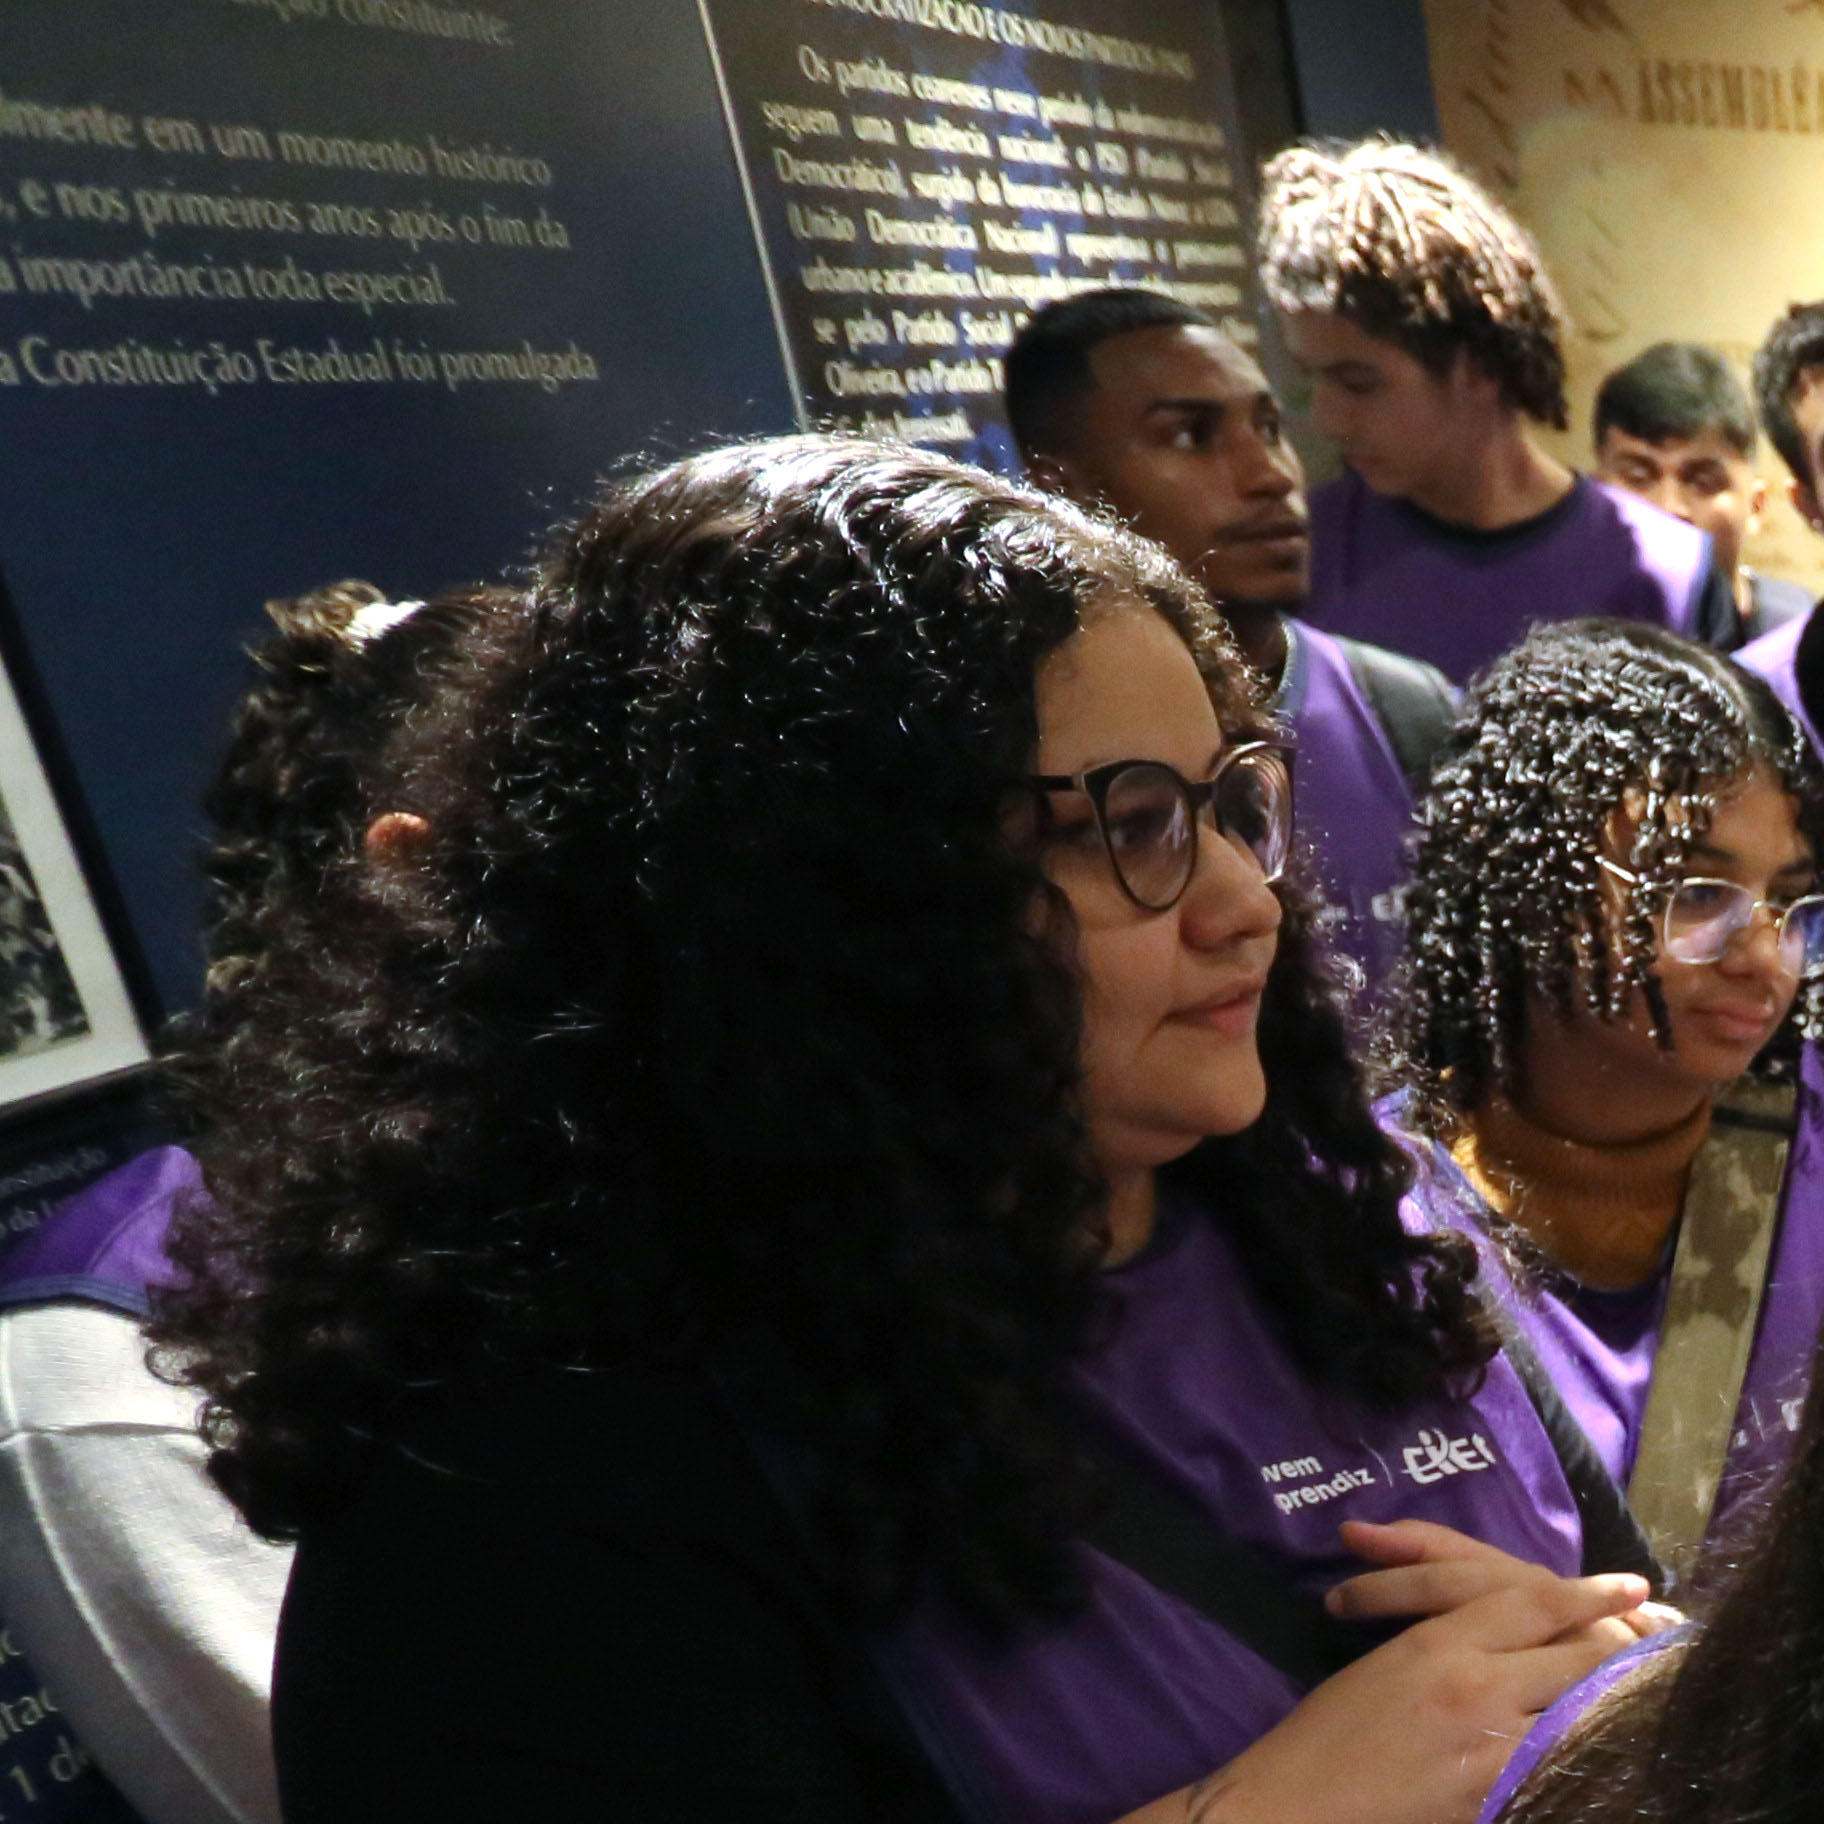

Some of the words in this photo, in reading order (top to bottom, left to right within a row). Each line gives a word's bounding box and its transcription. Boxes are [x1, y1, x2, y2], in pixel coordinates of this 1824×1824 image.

[798, 44, 831, 83] Os
[277, 131, 427, 178] momento
[428, 134, 553, 187] histórico
[133, 177, 302, 239] primeiros
[305, 200, 383, 238] anos
[385, 201, 458, 253] após
[11, 242, 244, 311] importância
[19, 333, 256, 396] Constituição
[257, 336, 392, 384] Estadual
[438, 339, 601, 395] promulgada
[1273, 1465, 1377, 1516] prendiz
